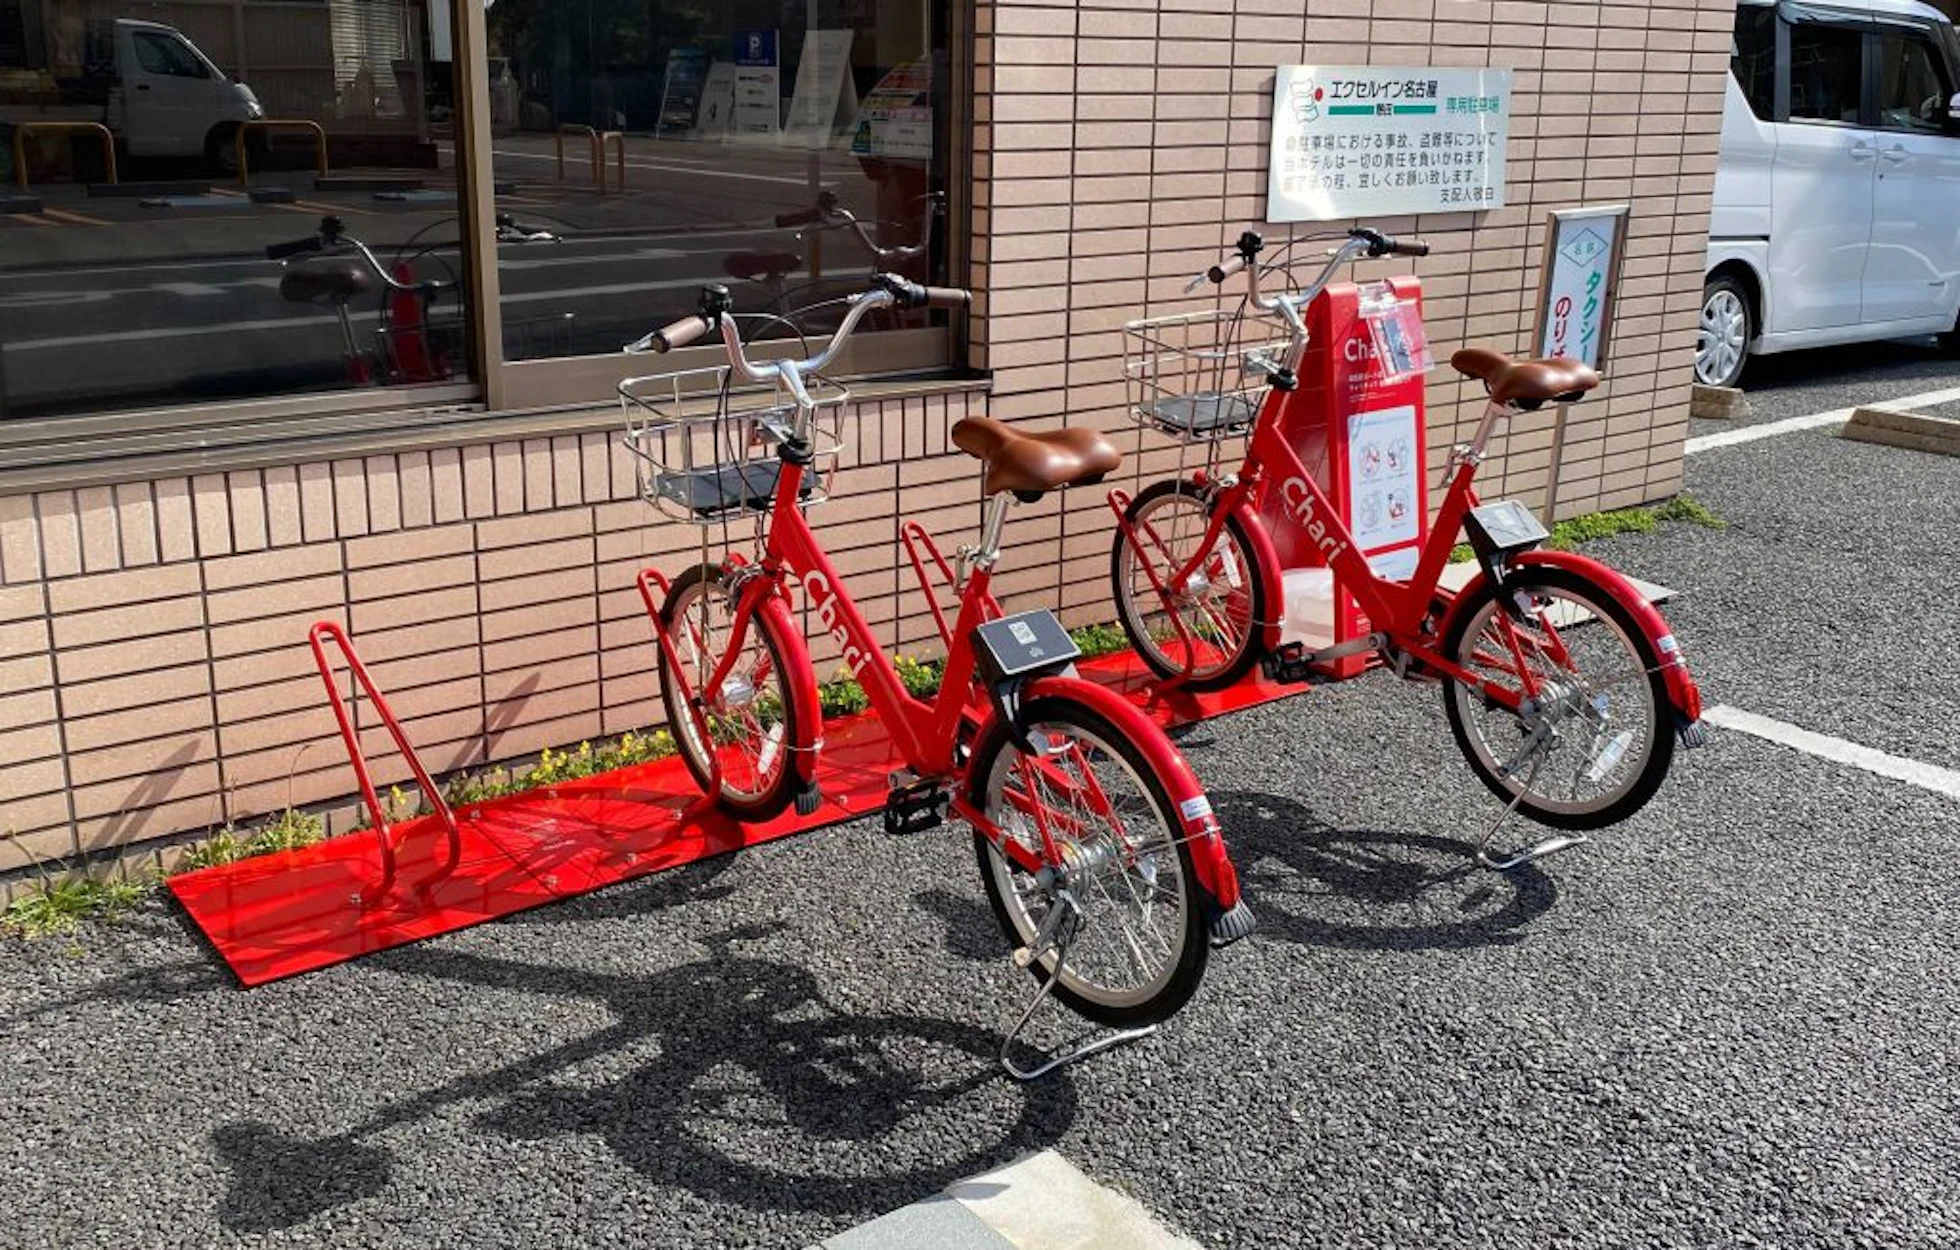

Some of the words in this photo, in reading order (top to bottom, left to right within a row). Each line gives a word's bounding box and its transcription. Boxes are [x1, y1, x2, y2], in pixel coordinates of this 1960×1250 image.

[1330, 80, 1438, 99] エクセルイン名古屋
[1447, 96, 1499, 114] 専用駐車場
[1581, 271, 1601, 363] タクシー
[1283, 476, 1347, 563] Chari
[803, 570, 872, 680] Chari
